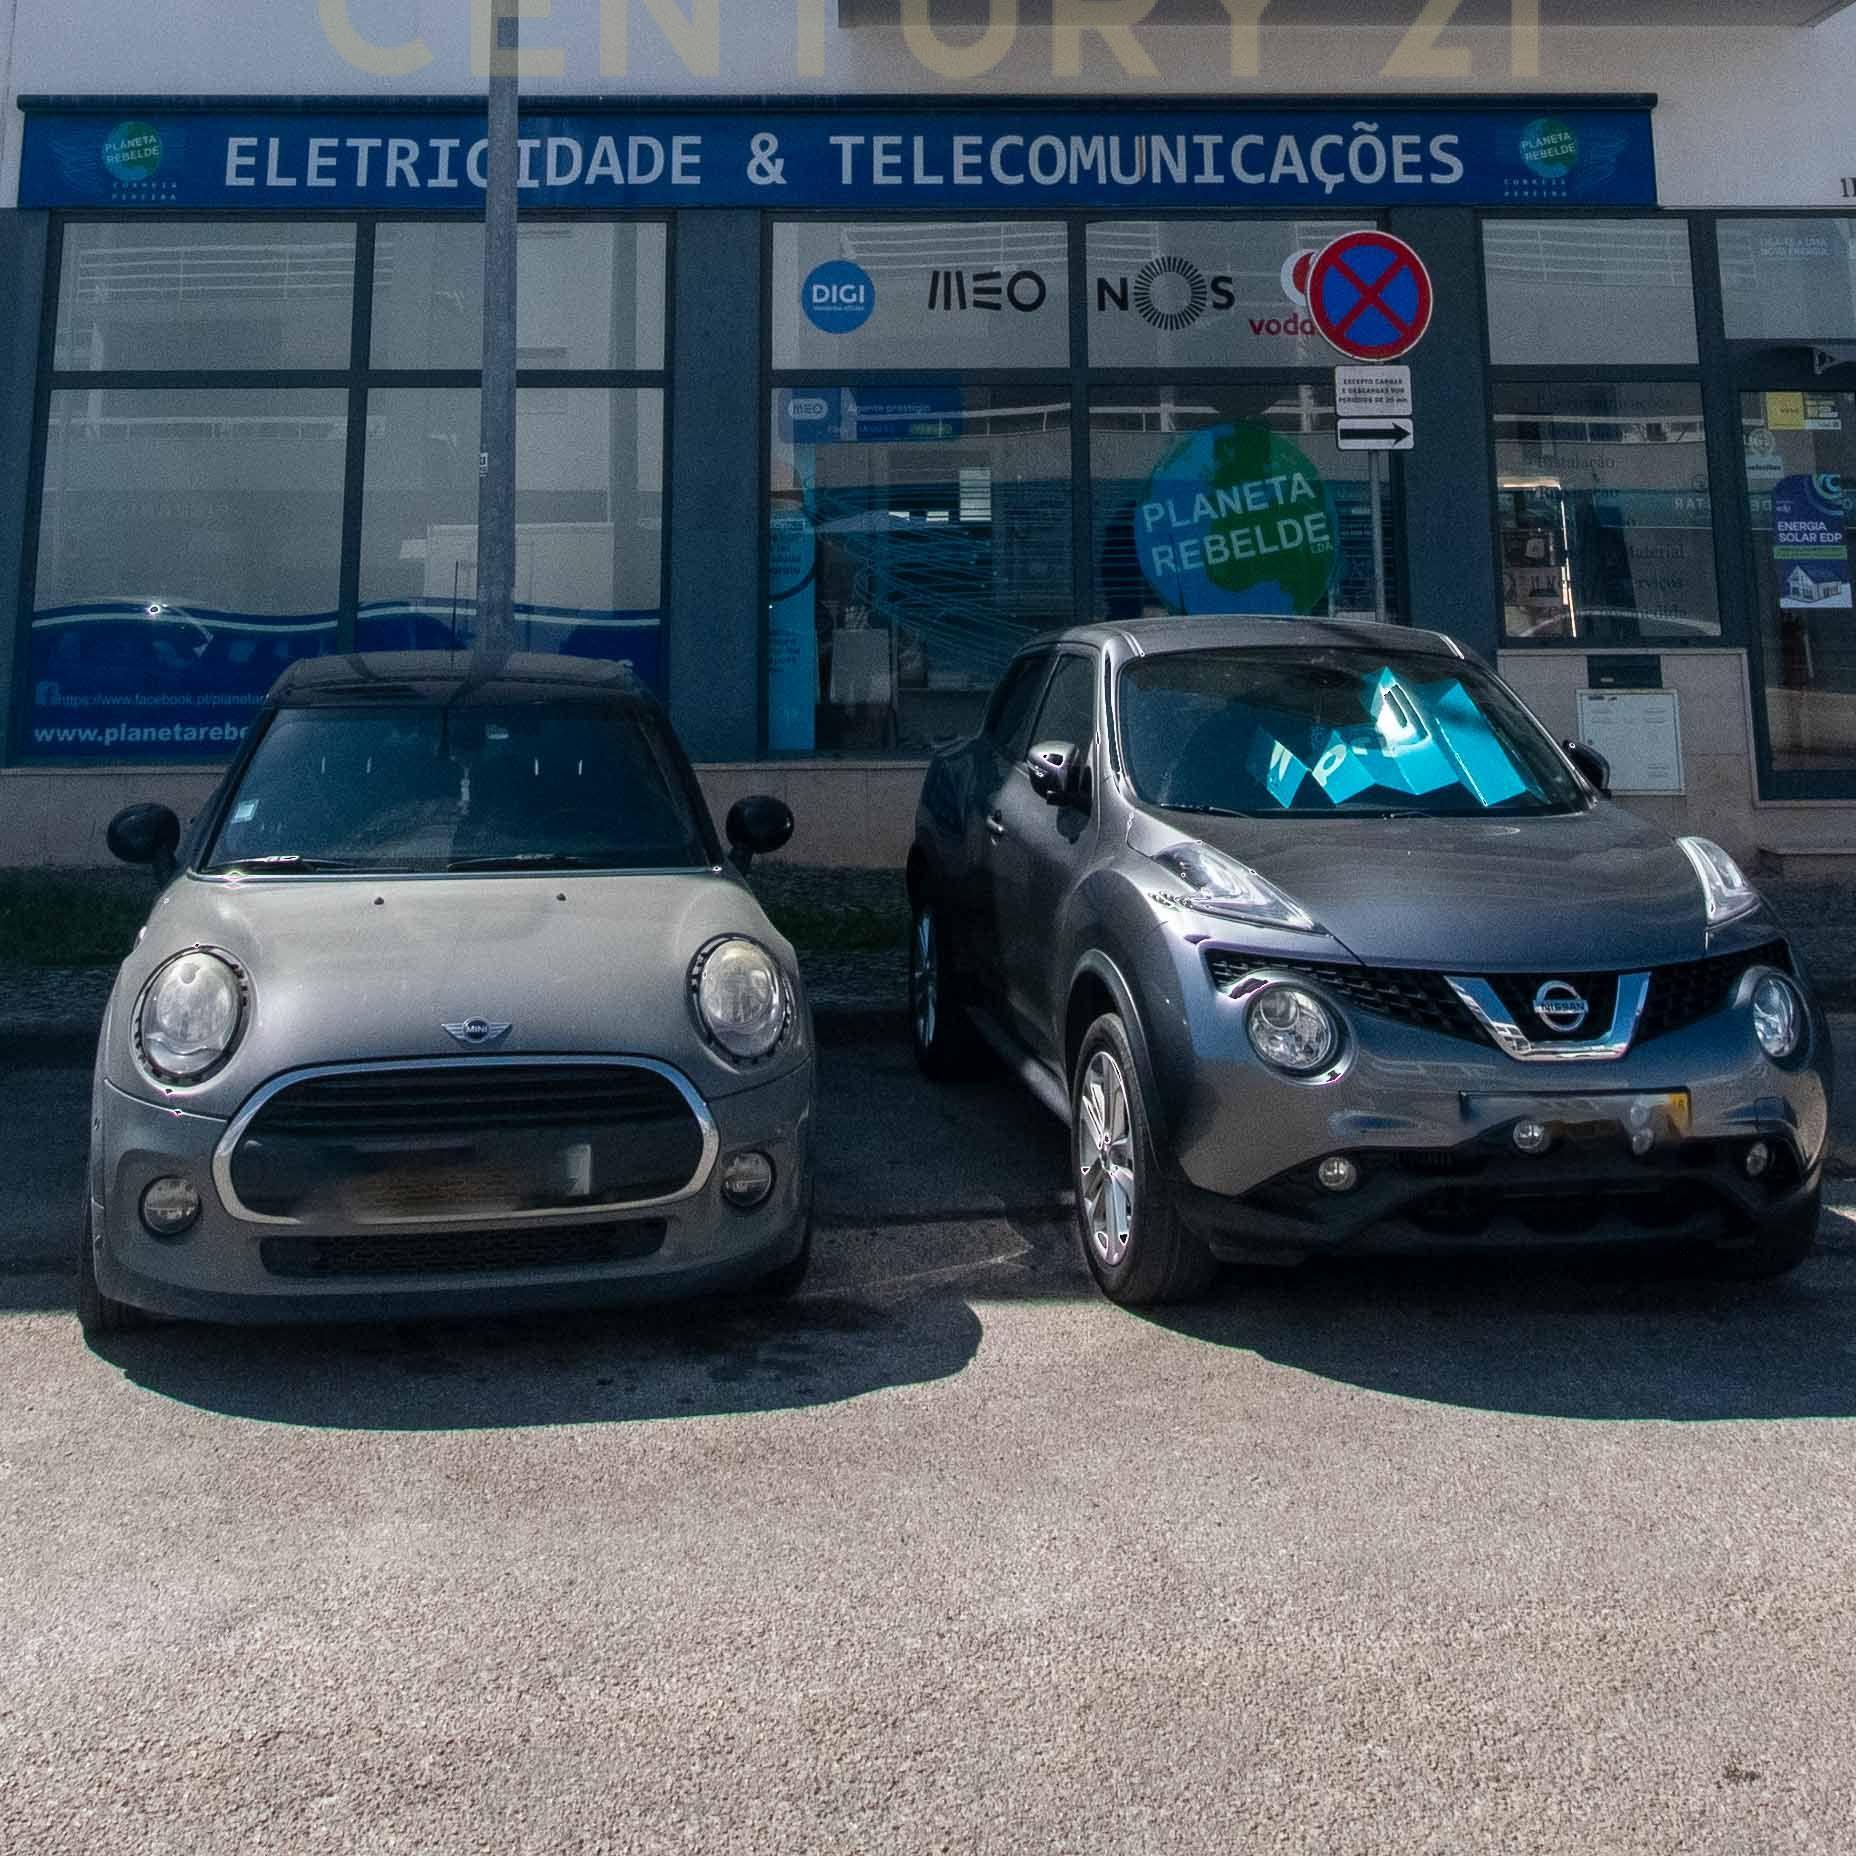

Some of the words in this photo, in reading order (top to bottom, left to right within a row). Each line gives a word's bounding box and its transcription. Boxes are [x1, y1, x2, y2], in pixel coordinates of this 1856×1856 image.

[105, 135, 157, 153] PLANETA
[1521, 132, 1572, 150] PLANETA
[106, 146, 160, 163] REBELDE
[746, 132, 787, 186] &
[830, 122, 1464, 194] TELECOMUNICAÇÕES
[1524, 143, 1576, 161] REBELDE
[812, 284, 865, 304] DIGI
[928, 271, 1046, 312] MEO
[1097, 256, 1236, 331] NOS
[1249, 313, 1317, 336] voda
[1142, 472, 1316, 533] PLANETA
[1778, 521, 1827, 532] ENERGIA
[1151, 511, 1331, 576] REBELDE
[1779, 532, 1817, 543] SOLAR
[1819, 532, 1843, 543] EDP
[465, 1025, 488, 1033] MINI
